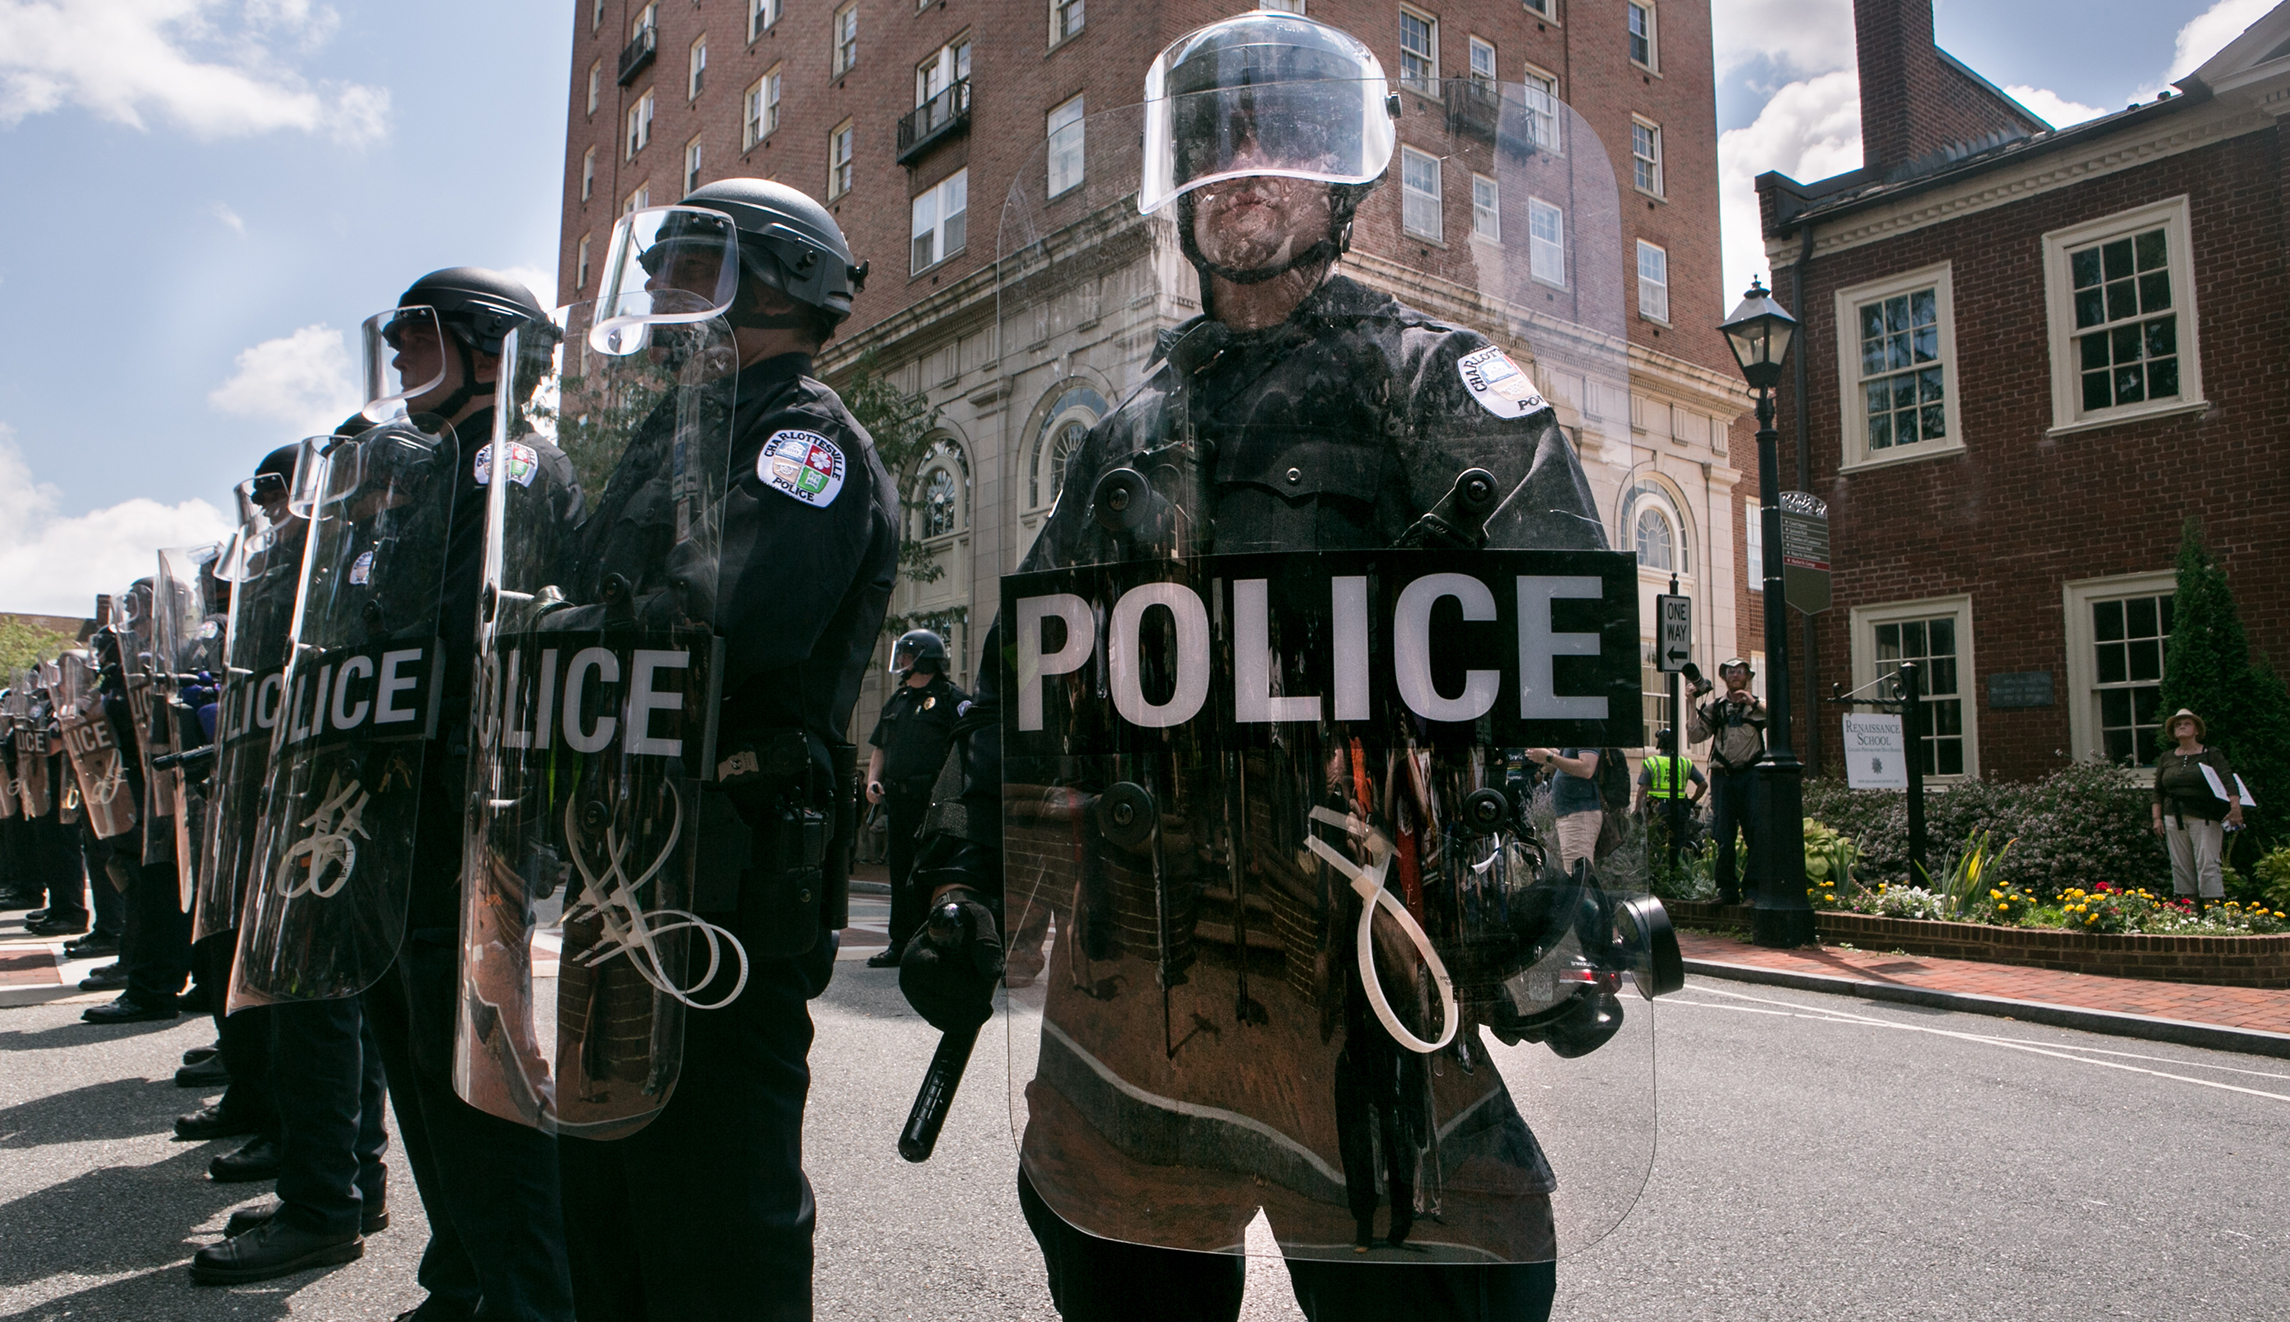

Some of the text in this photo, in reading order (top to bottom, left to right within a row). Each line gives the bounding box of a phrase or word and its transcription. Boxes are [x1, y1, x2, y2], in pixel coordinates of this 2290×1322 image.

[764, 432, 843, 481] CHARLOTTESVILLE
[772, 477, 815, 502] POLICE
[1667, 602, 1687, 621] ONE
[1666, 623, 1688, 642] WAY
[1016, 572, 1610, 731] POLICE
[226, 672, 284, 742] LIC
[276, 647, 422, 752] LICE
[66, 721, 112, 756] LICE
[1846, 720, 1901, 734] RENAISSANCE
[1857, 732, 1892, 746] SCHOOL
[18, 732, 46, 752] LICE
